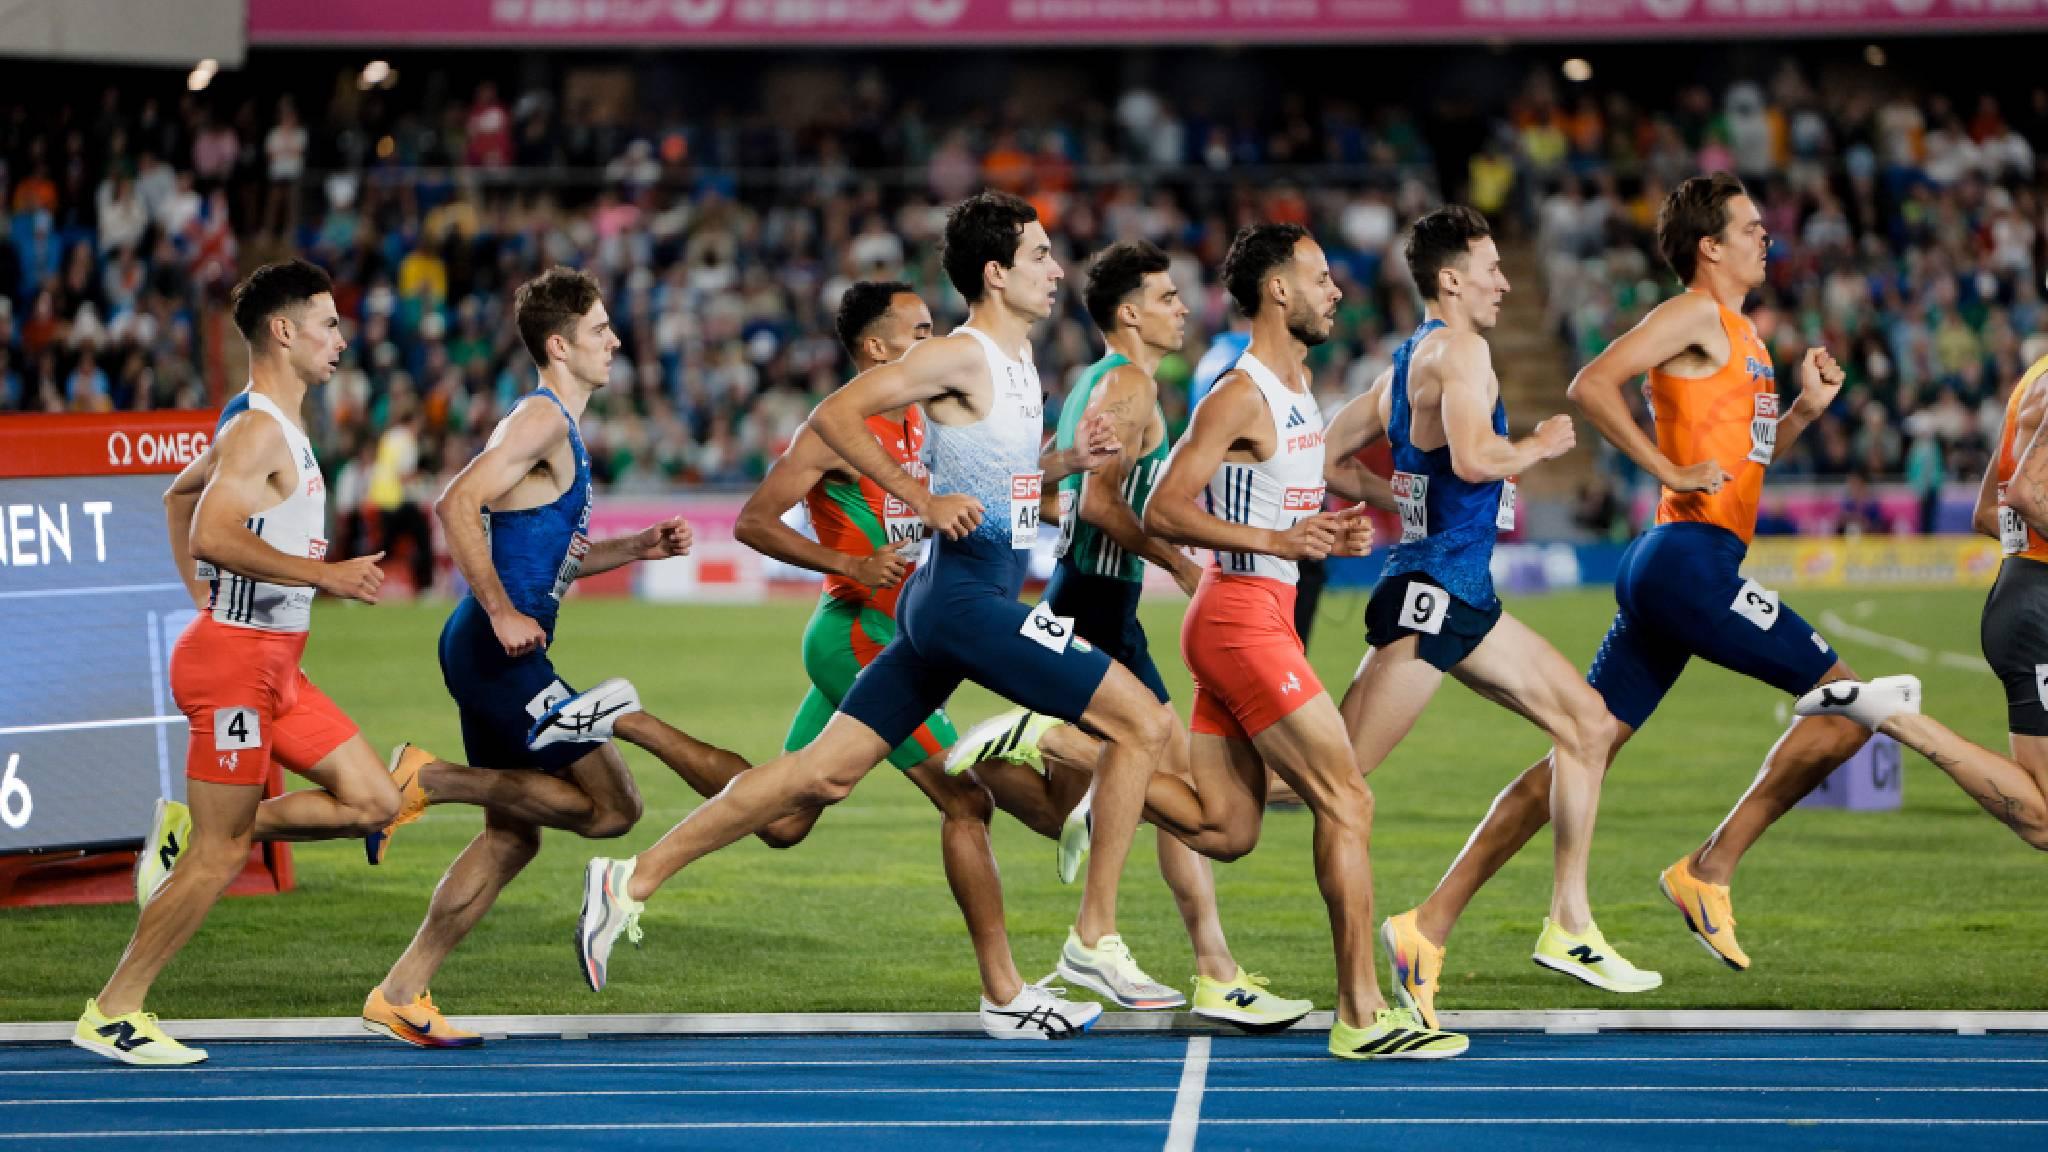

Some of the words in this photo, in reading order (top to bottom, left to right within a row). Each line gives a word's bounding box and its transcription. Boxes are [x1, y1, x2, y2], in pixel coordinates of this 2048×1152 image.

[0, 502, 72, 566] EN
[83, 501, 112, 563] T
[1412, 591, 1436, 624] 9
[1746, 590, 1774, 615] 3
[1034, 614, 1065, 637] 8
[228, 711, 249, 742] 4
[1, 753, 33, 828] 6
